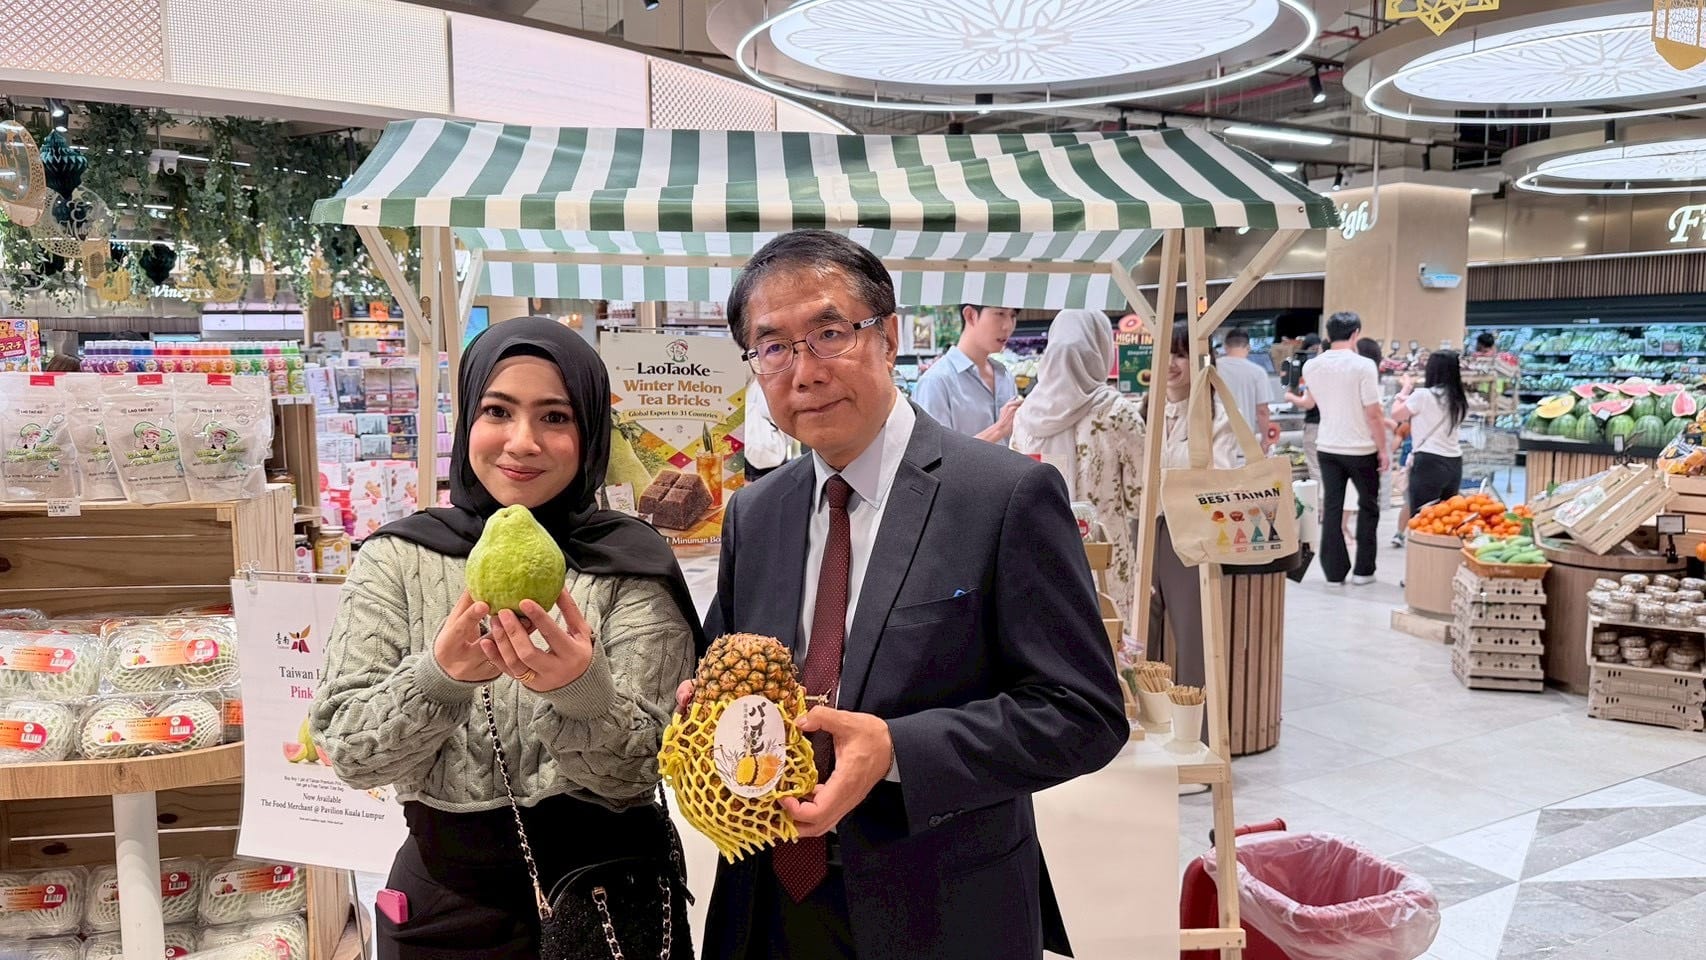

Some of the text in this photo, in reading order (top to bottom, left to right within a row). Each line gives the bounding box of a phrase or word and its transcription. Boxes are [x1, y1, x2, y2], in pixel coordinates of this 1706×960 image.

[1339, 201, 1369, 240] igh
[1116, 333, 1139, 345] HIGH
[638, 362, 710, 376] LaoTaoKe
[623, 380, 722, 394] Winter Melon
[638, 394, 710, 407] Tea Bricks
[688, 411, 718, 419] Countries
[1198, 494, 1231, 505] BEST
[1233, 487, 1280, 501] TAINAN
[672, 537, 709, 545] Minuman
[279, 666, 314, 680] Taiwan
[290, 686, 314, 699] Pink
[303, 793, 342, 804] Now Available
[261, 799, 385, 821] The Food Merchant @ Pavilion Kuala Lumpur
